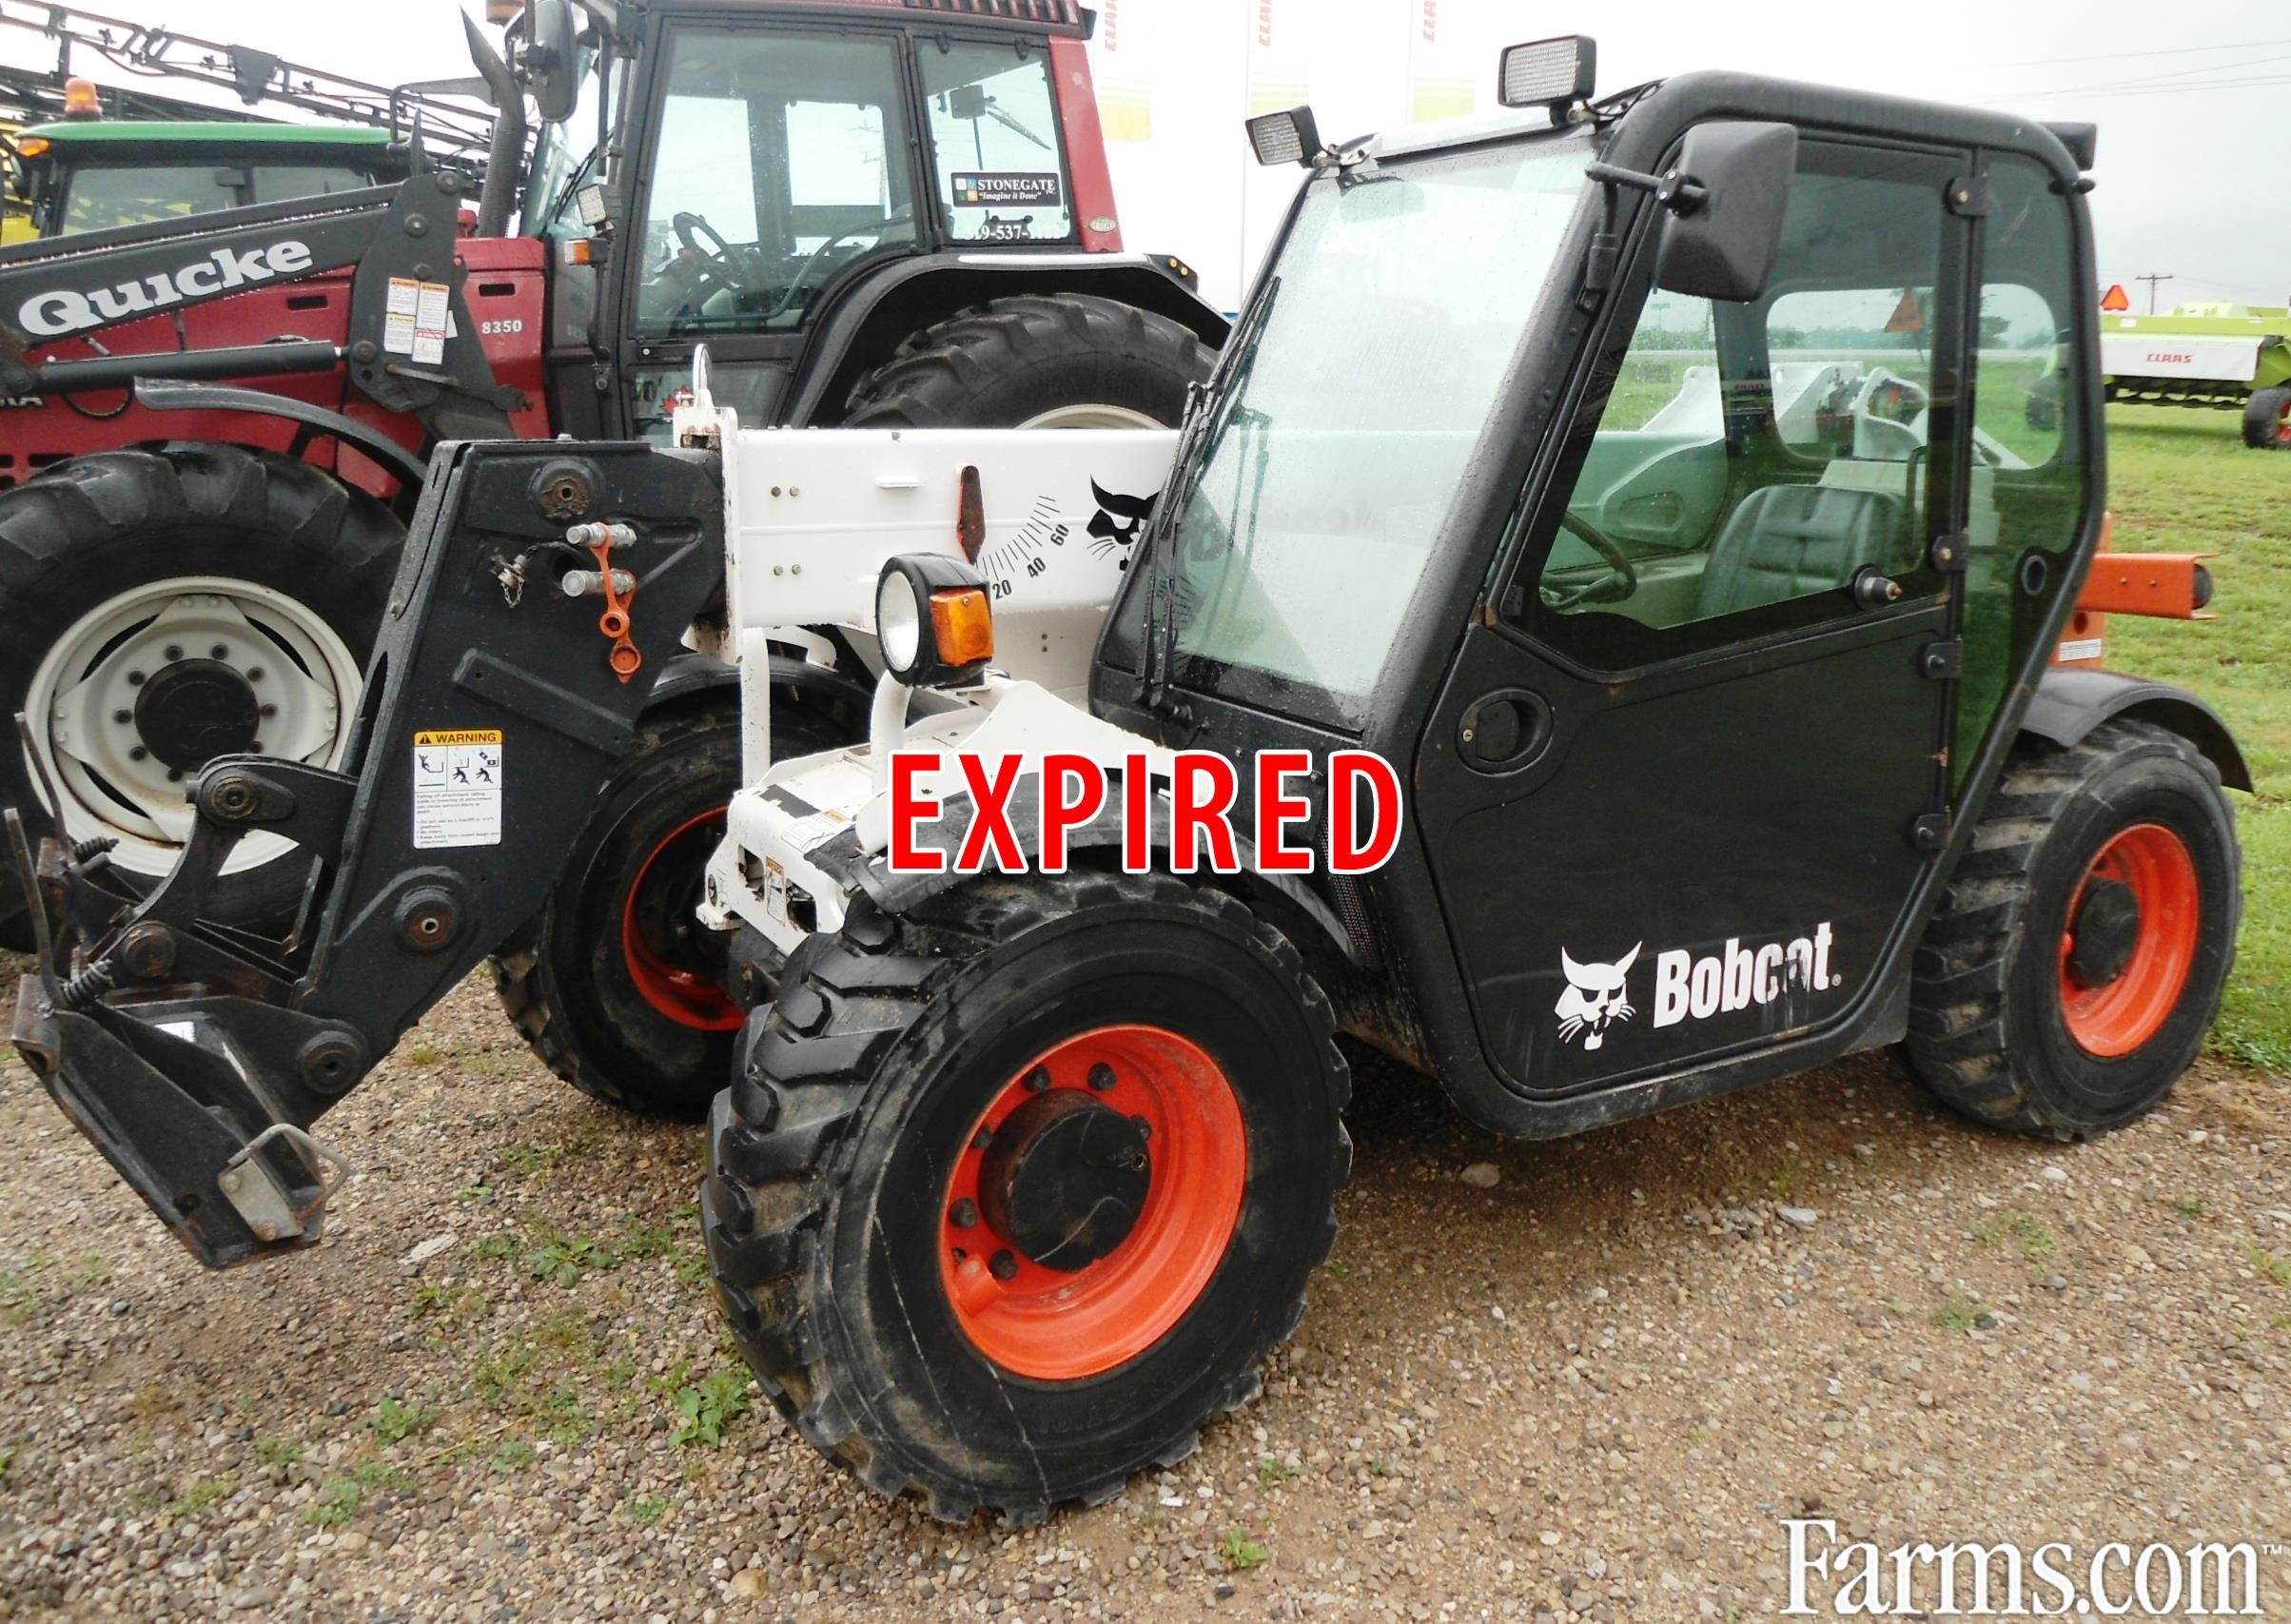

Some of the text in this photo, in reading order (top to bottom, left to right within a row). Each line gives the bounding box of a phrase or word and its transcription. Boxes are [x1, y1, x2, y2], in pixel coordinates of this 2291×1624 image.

[977, 179, 1056, 191] STONEGATE
[19, 241, 313, 336] Quicke
[481, 320, 522, 334] 8350
[2146, 353, 2193, 363] CLAAS
[1050, 524, 1069, 546] 60
[1028, 557, 1047, 578] 40
[992, 579, 1012, 600] 20
[436, 733, 496, 743] WARNING
